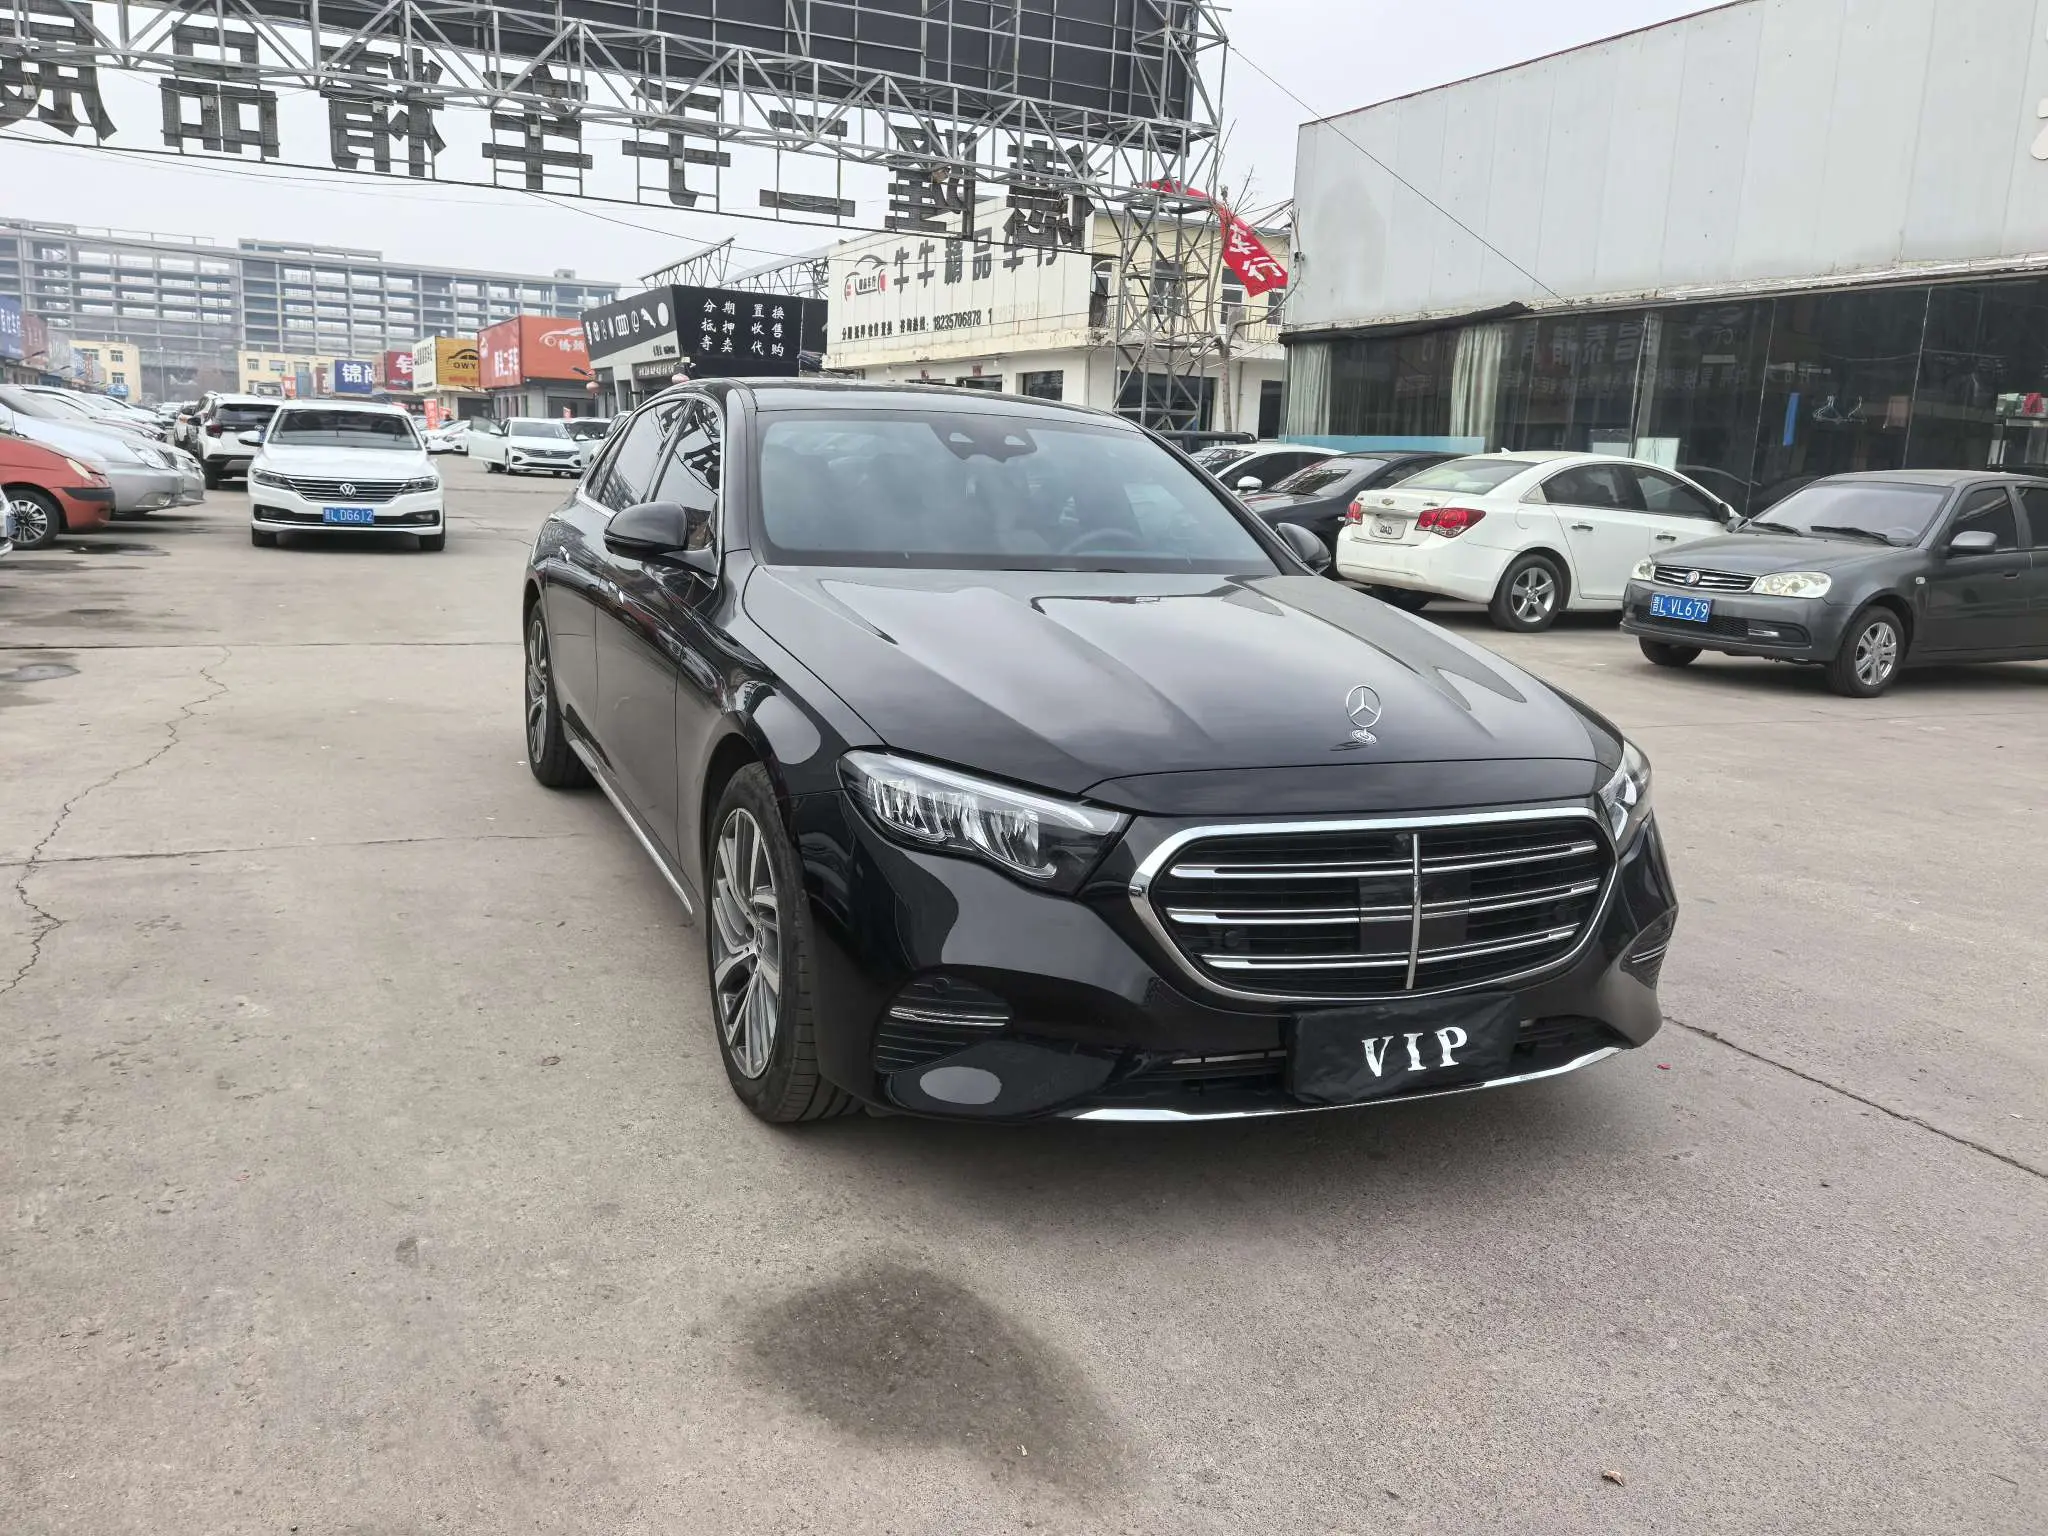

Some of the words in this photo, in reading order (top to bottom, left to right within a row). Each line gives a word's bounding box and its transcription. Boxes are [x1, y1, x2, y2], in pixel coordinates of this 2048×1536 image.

[703, 299, 736, 315] 分期
[752, 303, 785, 319] 置换
[701, 317, 736, 335] 抵押
[751, 321, 784, 338] 收售
[700, 335, 733, 353] 寄卖
[751, 340, 785, 357] 代购
[1361, 1026, 1468, 1077] VIP
